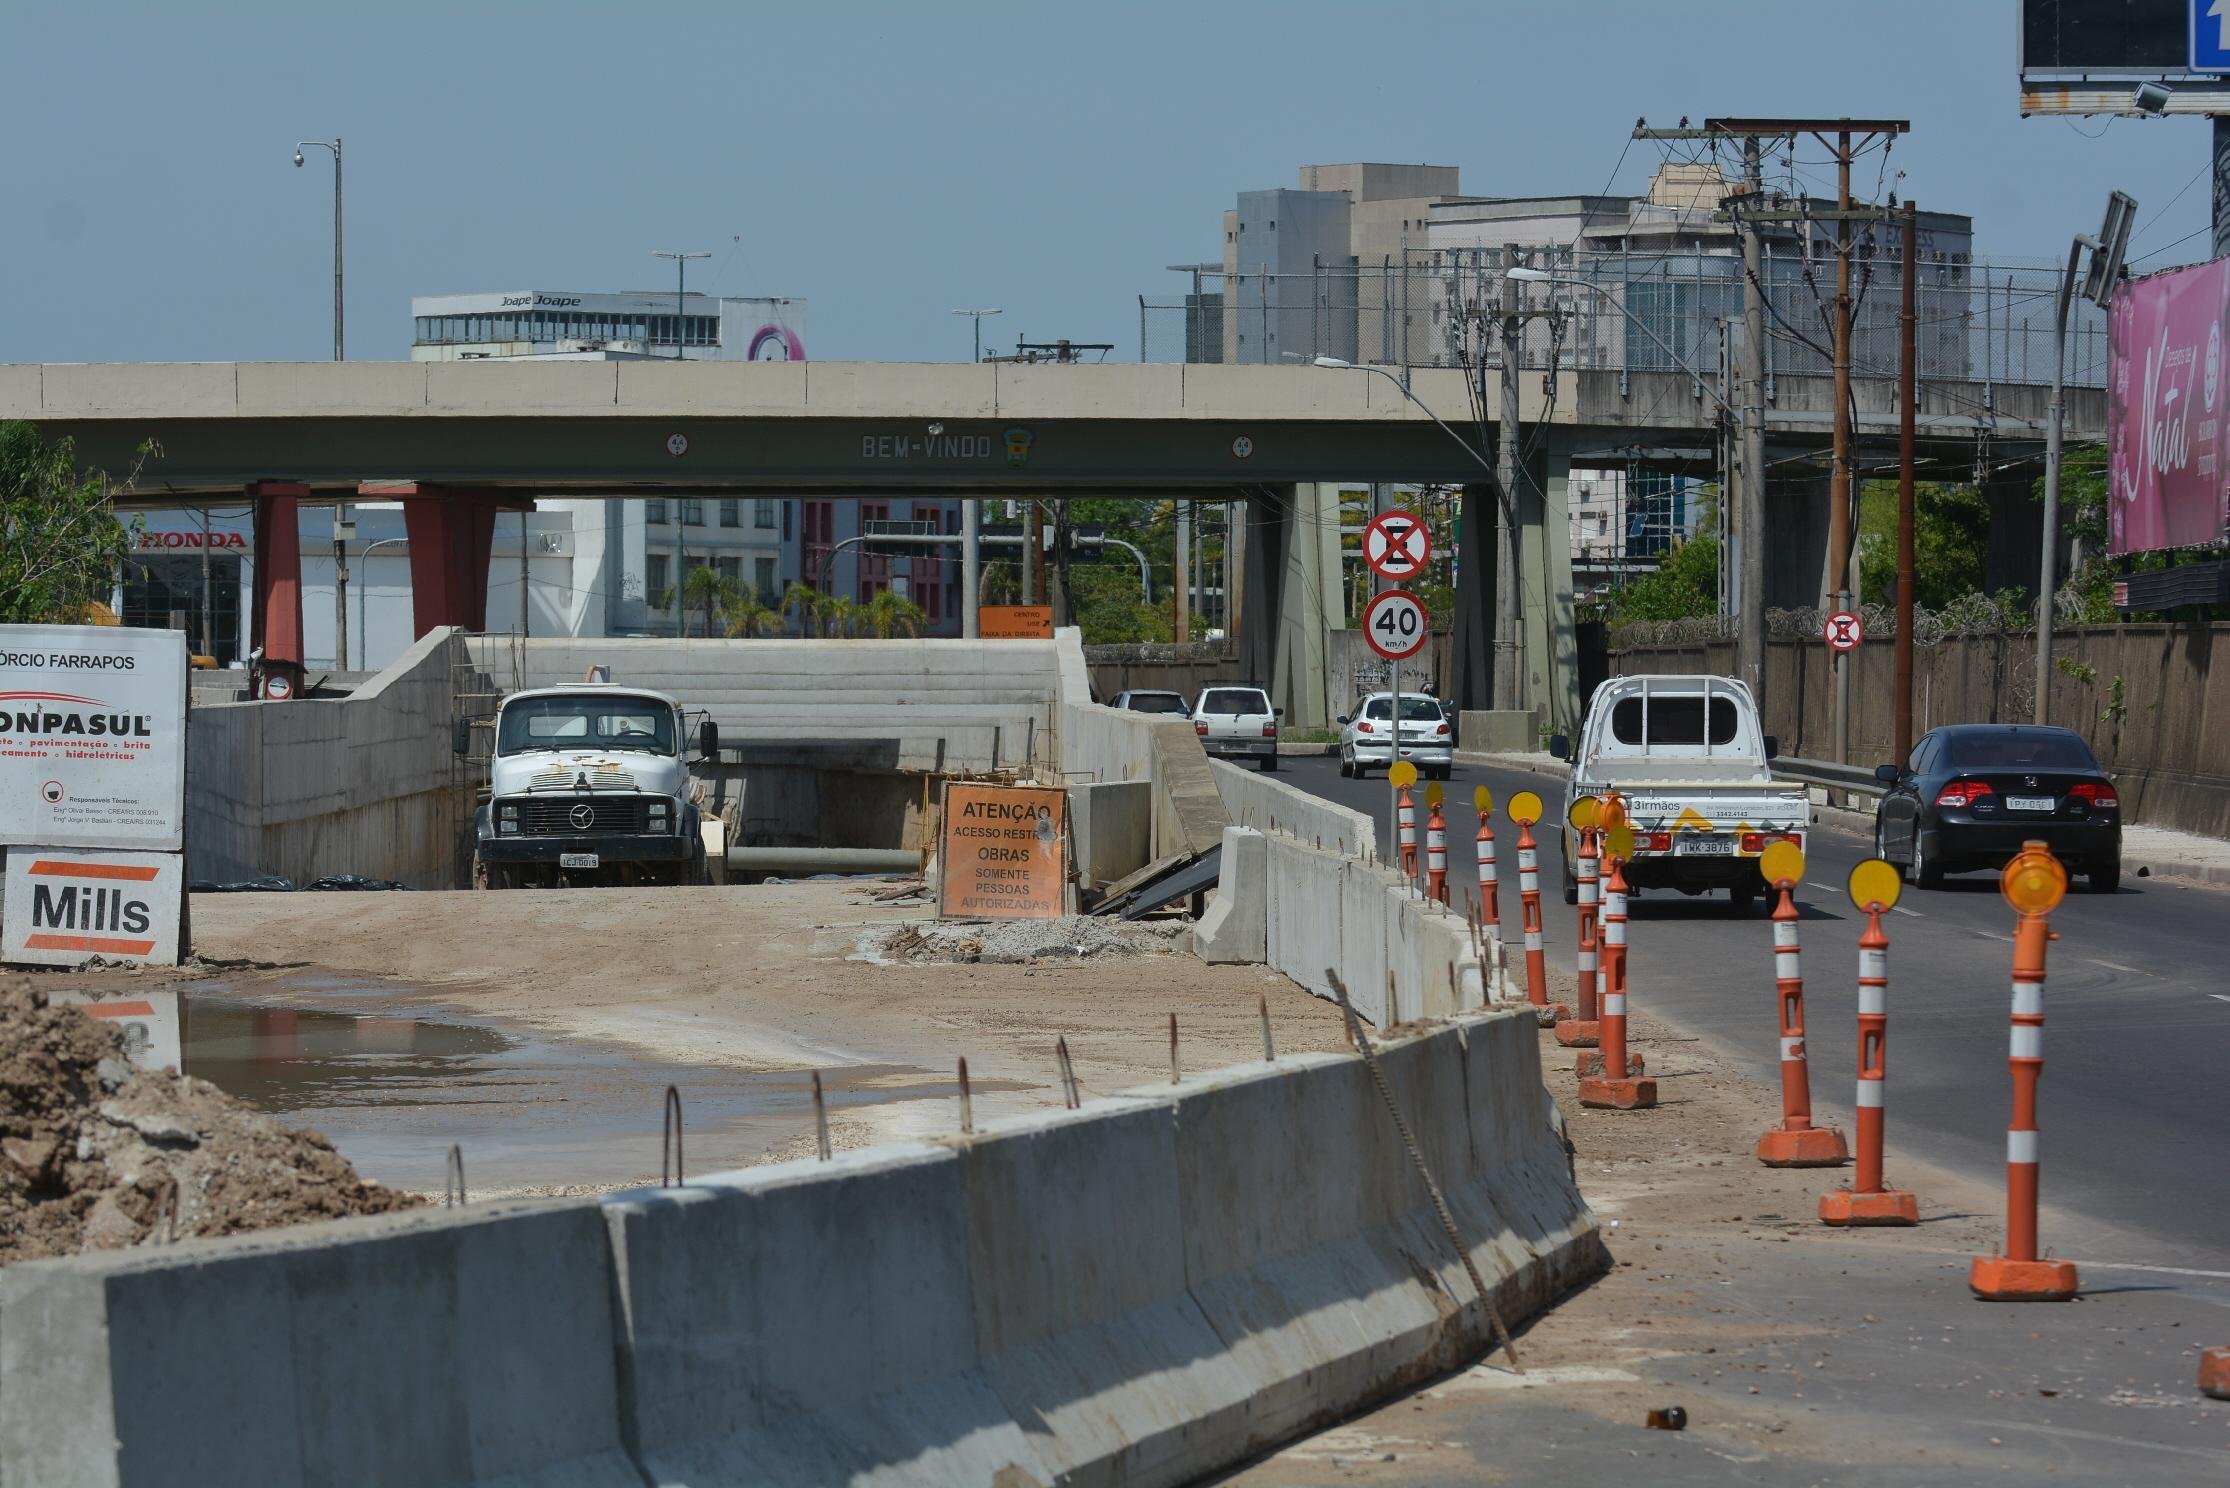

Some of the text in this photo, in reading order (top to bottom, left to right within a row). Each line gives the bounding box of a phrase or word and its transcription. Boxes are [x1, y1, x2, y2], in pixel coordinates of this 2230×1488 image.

[501, 296, 532, 307] Joape
[534, 295, 581, 307] Joape
[862, 435, 991, 458] BEM-VINDO
[141, 532, 248, 548] HONDA
[1376, 607, 1417, 636] 40
[1385, 640, 1408, 649] km/h
[49, 654, 135, 670] FARRAPOS
[123, 741, 151, 749] brita
[963, 801, 1051, 824] ATENÇÃO
[954, 826, 1000, 838] ACESSO
[978, 847, 1030, 862] OBRAS
[975, 867, 1030, 880] SOMENTE
[975, 883, 1030, 895] PESSOAS
[32, 884, 150, 934] Mills
[961, 896, 1049, 910] AUTORIZADAS
